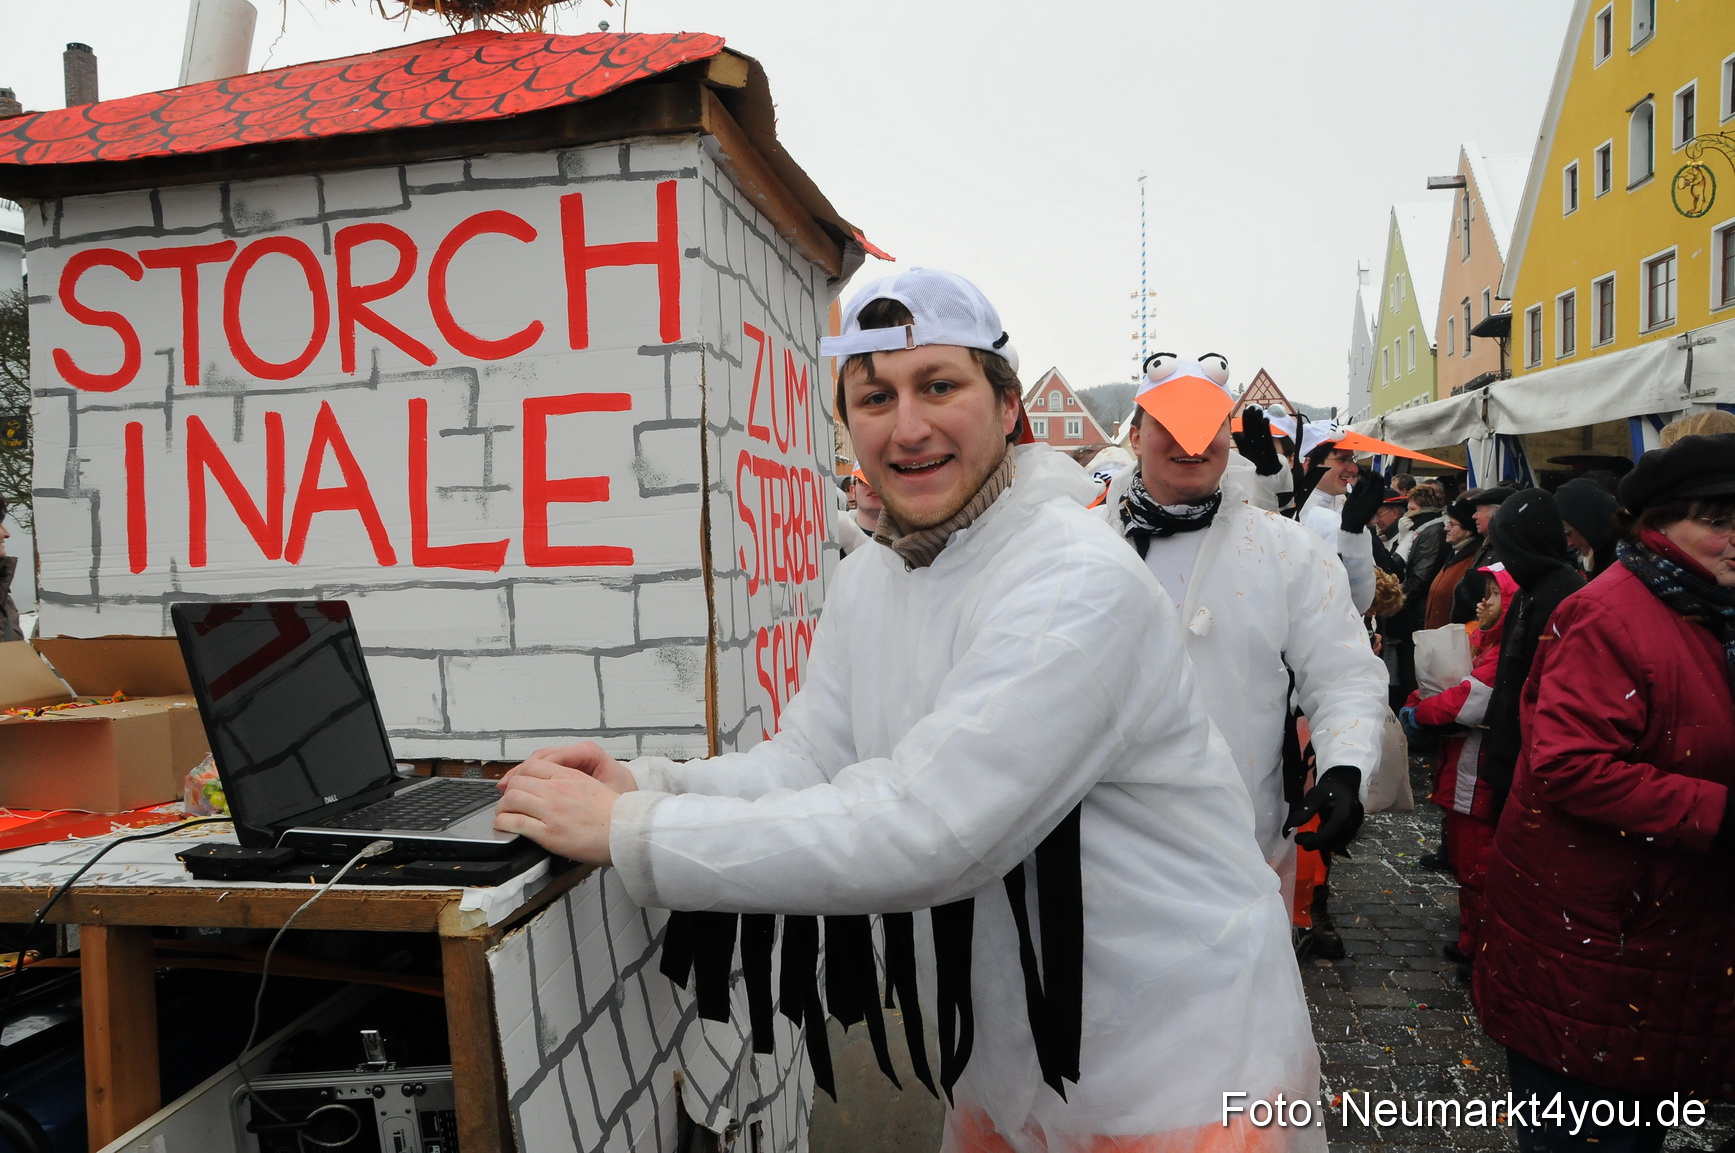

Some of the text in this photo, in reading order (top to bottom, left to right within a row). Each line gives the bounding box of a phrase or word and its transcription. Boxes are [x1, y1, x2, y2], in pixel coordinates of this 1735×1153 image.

[53, 179, 682, 393] STORCH
[743, 320, 811, 455] ZUM
[124, 392, 635, 574] INALE
[736, 448, 825, 598] STERBEN
[323, 794, 339, 805] DELL
